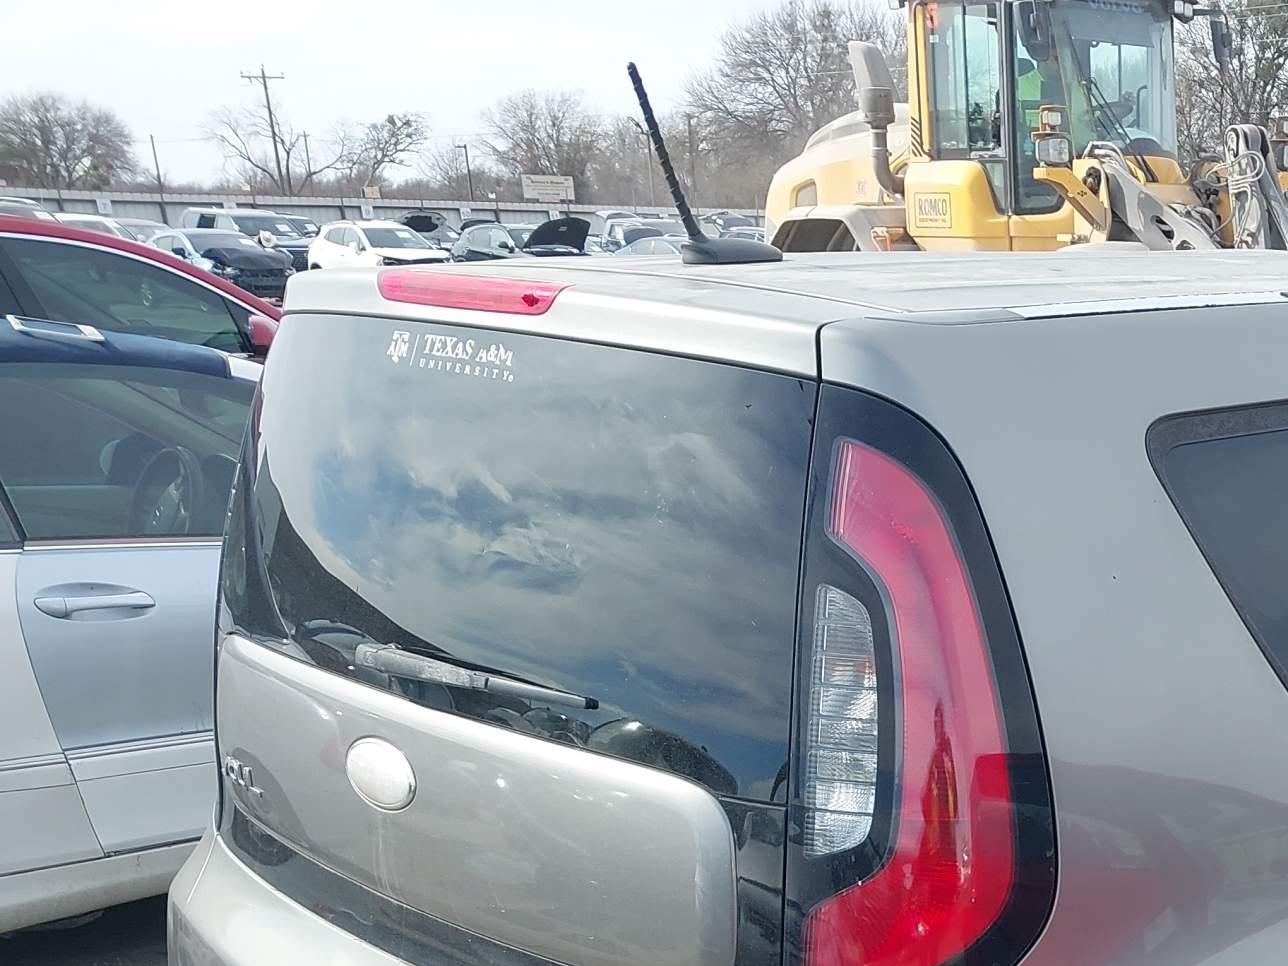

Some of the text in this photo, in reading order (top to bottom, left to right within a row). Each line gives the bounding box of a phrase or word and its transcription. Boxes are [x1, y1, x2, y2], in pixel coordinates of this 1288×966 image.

[918, 198, 948, 217] ROMCO
[424, 334, 513, 367] TEXAS A&M
